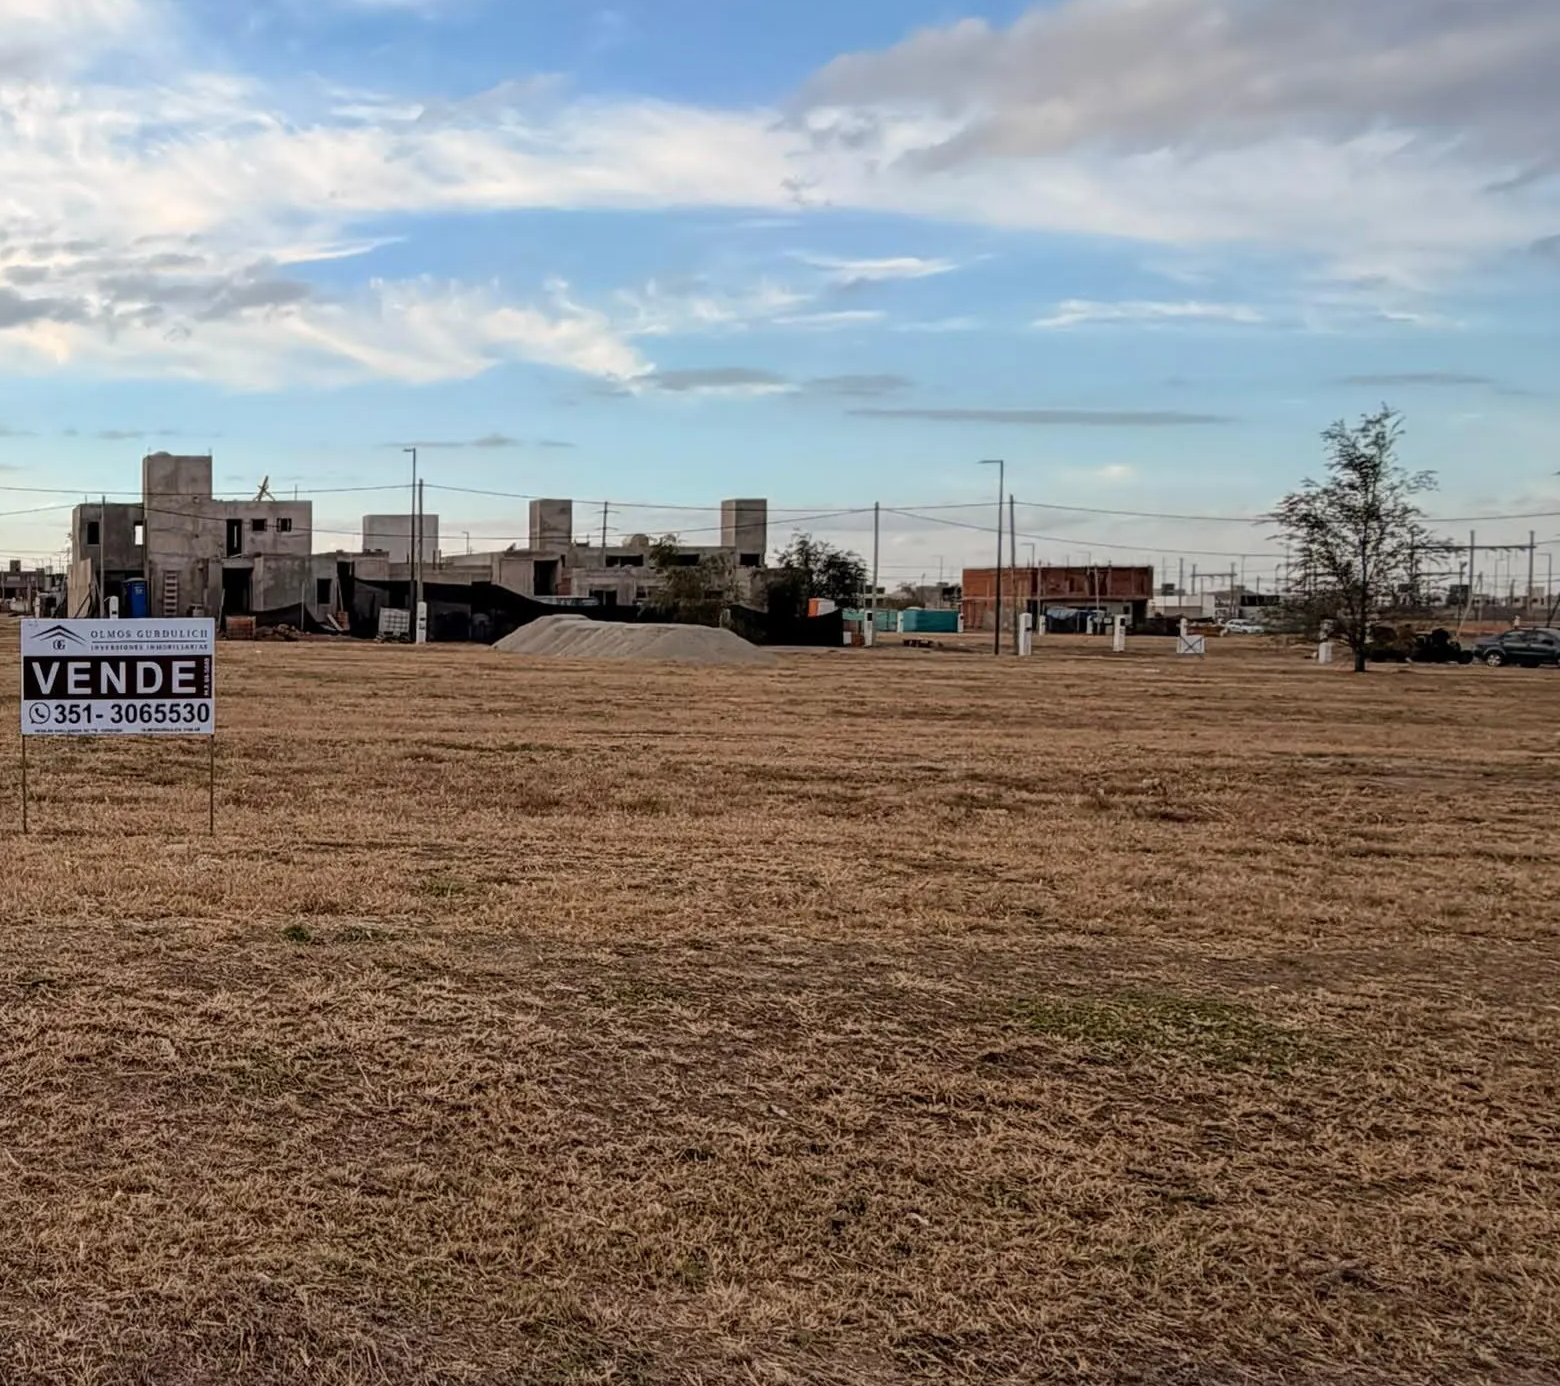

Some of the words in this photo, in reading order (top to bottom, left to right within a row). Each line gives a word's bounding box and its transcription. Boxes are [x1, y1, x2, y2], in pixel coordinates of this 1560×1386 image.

[90, 629, 132, 639] OLMOS
[31, 660, 197, 695] VENDE
[54, 703, 104, 725] 351-
[110, 702, 210, 724] 3065530
